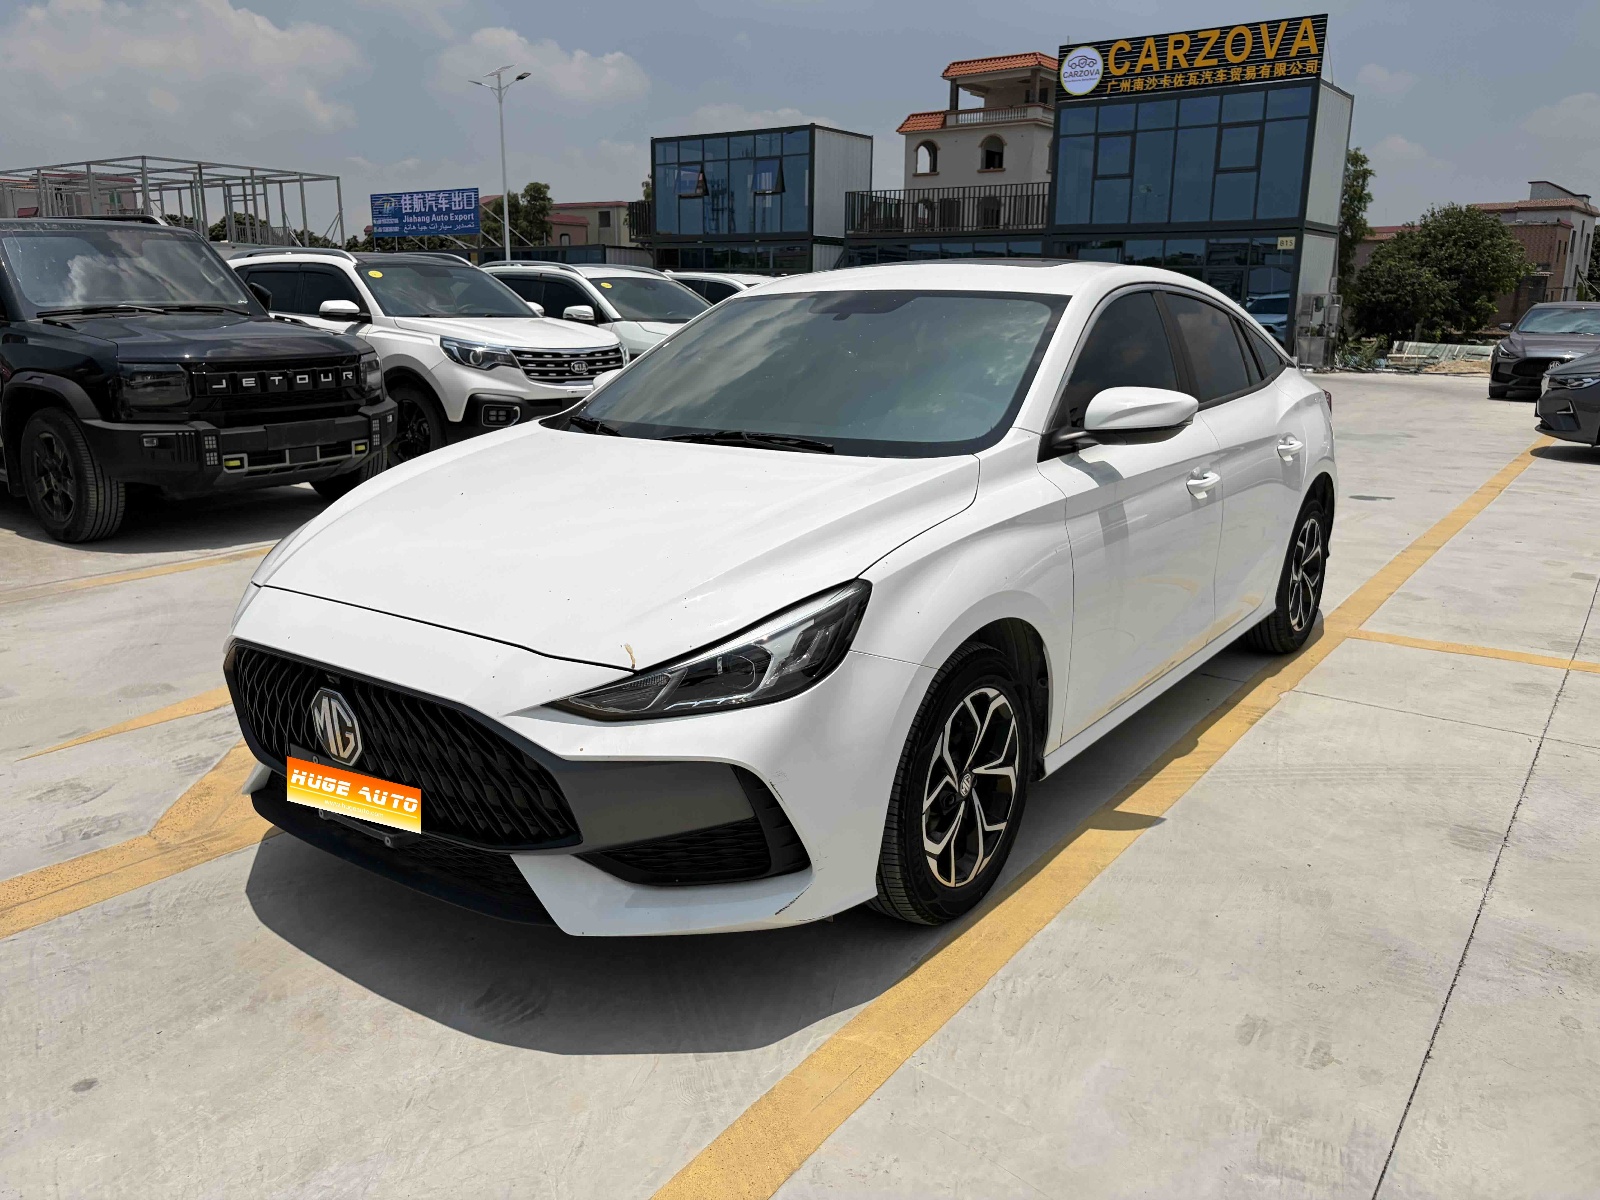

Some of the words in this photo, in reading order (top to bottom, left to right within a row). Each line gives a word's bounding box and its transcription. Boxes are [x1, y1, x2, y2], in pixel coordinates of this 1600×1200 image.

[1107, 18, 1319, 76] CARZOVA
[1063, 69, 1100, 78] CARZOVA
[1106, 59, 1318, 94] 广州南沙卡佐瓦汽车贸易有限公司
[401, 191, 475, 213] 佳航汽车出口
[403, 215, 430, 223] Jiahang
[431, 214, 448, 222] Auto
[450, 213, 474, 222] Export
[574, 363, 587, 371] KIA
[212, 371, 353, 388] JETOUR
[314, 696, 356, 759] MG
